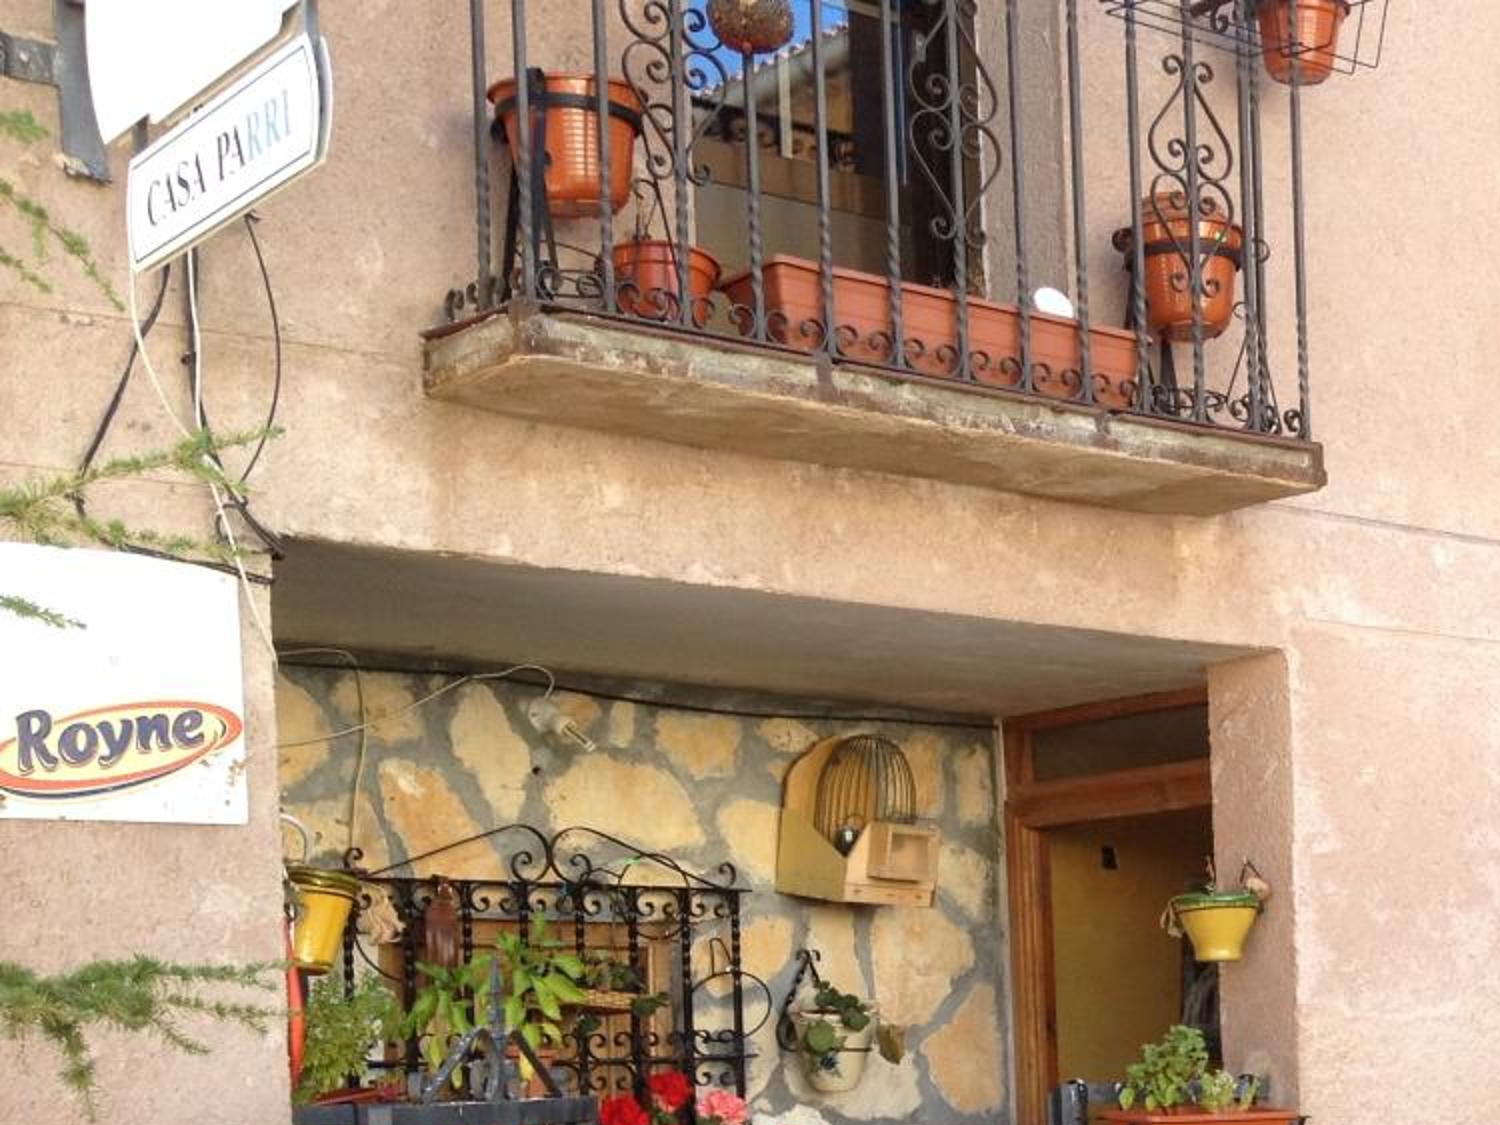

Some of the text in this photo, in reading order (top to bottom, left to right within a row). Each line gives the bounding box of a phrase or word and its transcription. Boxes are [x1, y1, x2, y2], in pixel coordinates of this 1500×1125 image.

[147, 90, 291, 226] CASA PARRI
[15, 709, 205, 775] Royne
